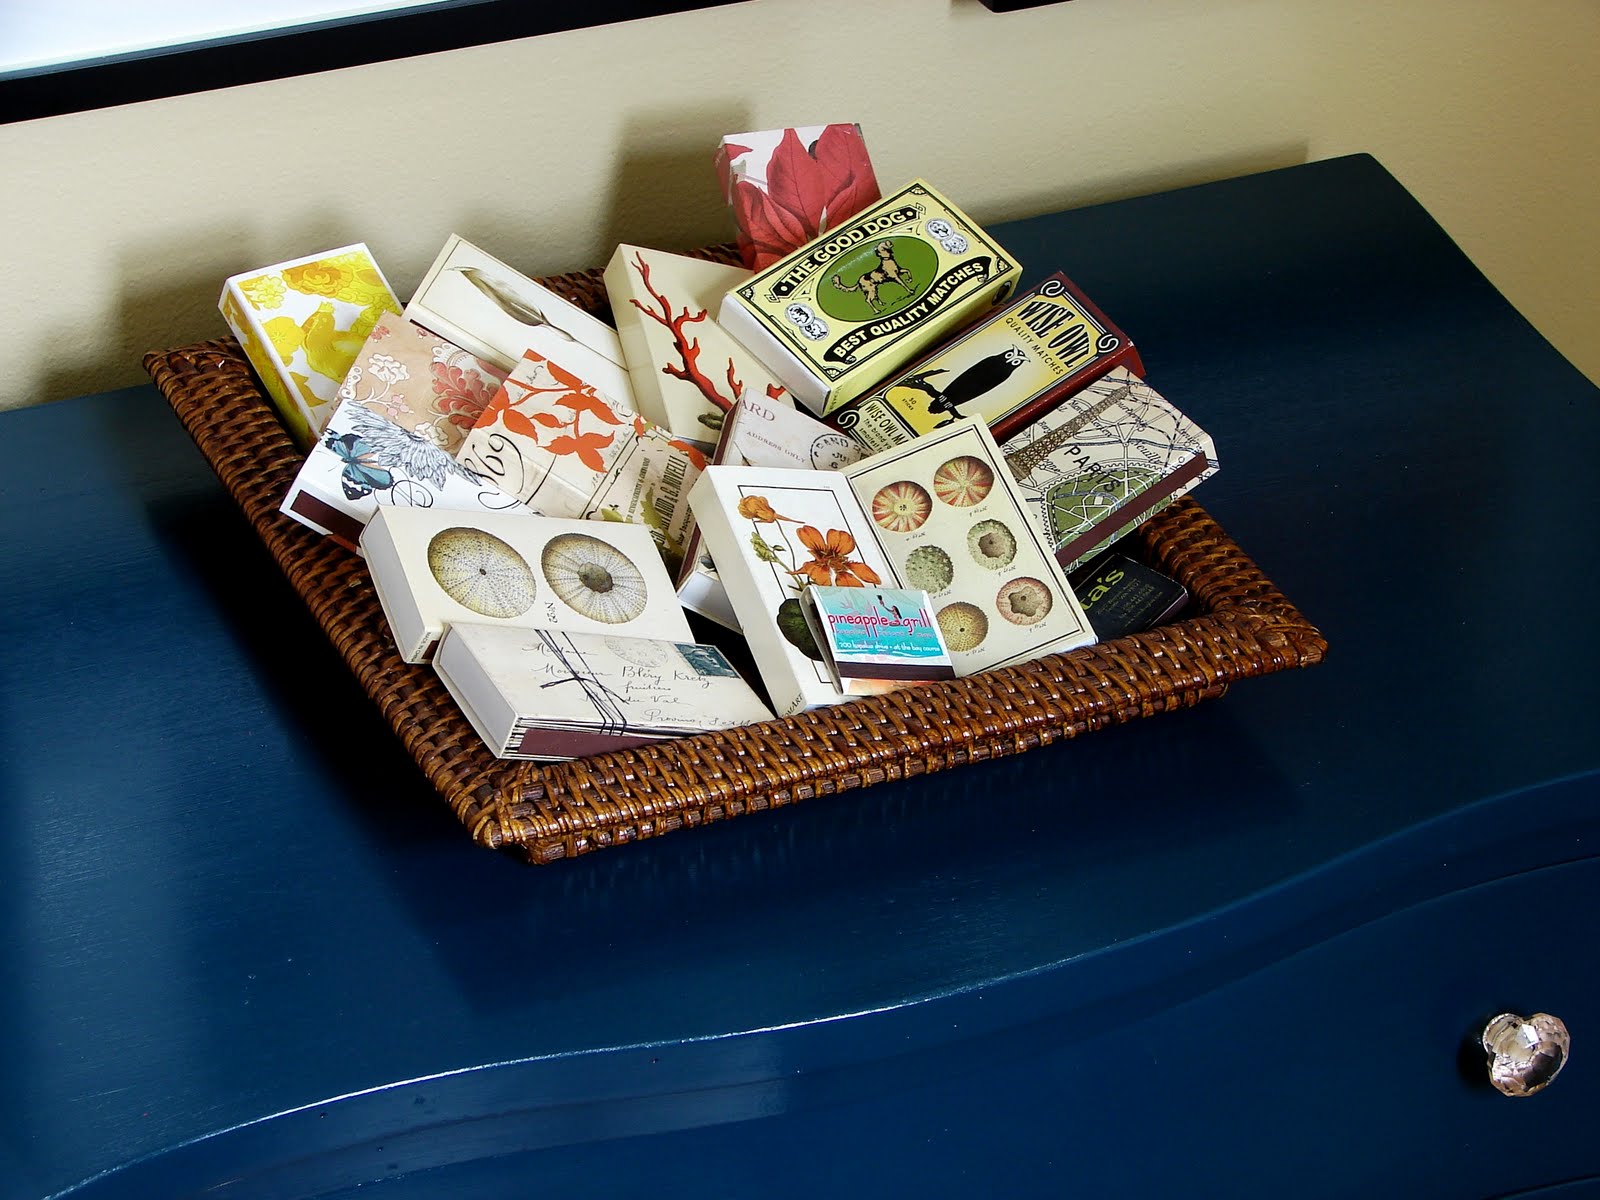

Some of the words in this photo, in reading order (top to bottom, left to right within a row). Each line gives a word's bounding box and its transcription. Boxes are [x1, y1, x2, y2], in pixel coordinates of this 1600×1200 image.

[781, 259, 819, 287] THE
[813, 229, 865, 262] GOOD
[862, 211, 907, 235] DOG
[833, 330, 868, 358] BEST
[870, 302, 929, 336] QUALITY
[926, 262, 984, 306] MATCHES
[1017, 301, 1075, 338] WISE
[1048, 324, 1090, 368] OWL
[1005, 317, 1035, 344] QUALITY
[1031, 345, 1064, 375] MATCHES
[865, 402, 886, 422] WISE
[879, 419, 899, 437] OWL
[1064, 446, 1121, 493] PARIS
[828, 606, 889, 638] pineapple
[902, 608, 932, 633] grill
